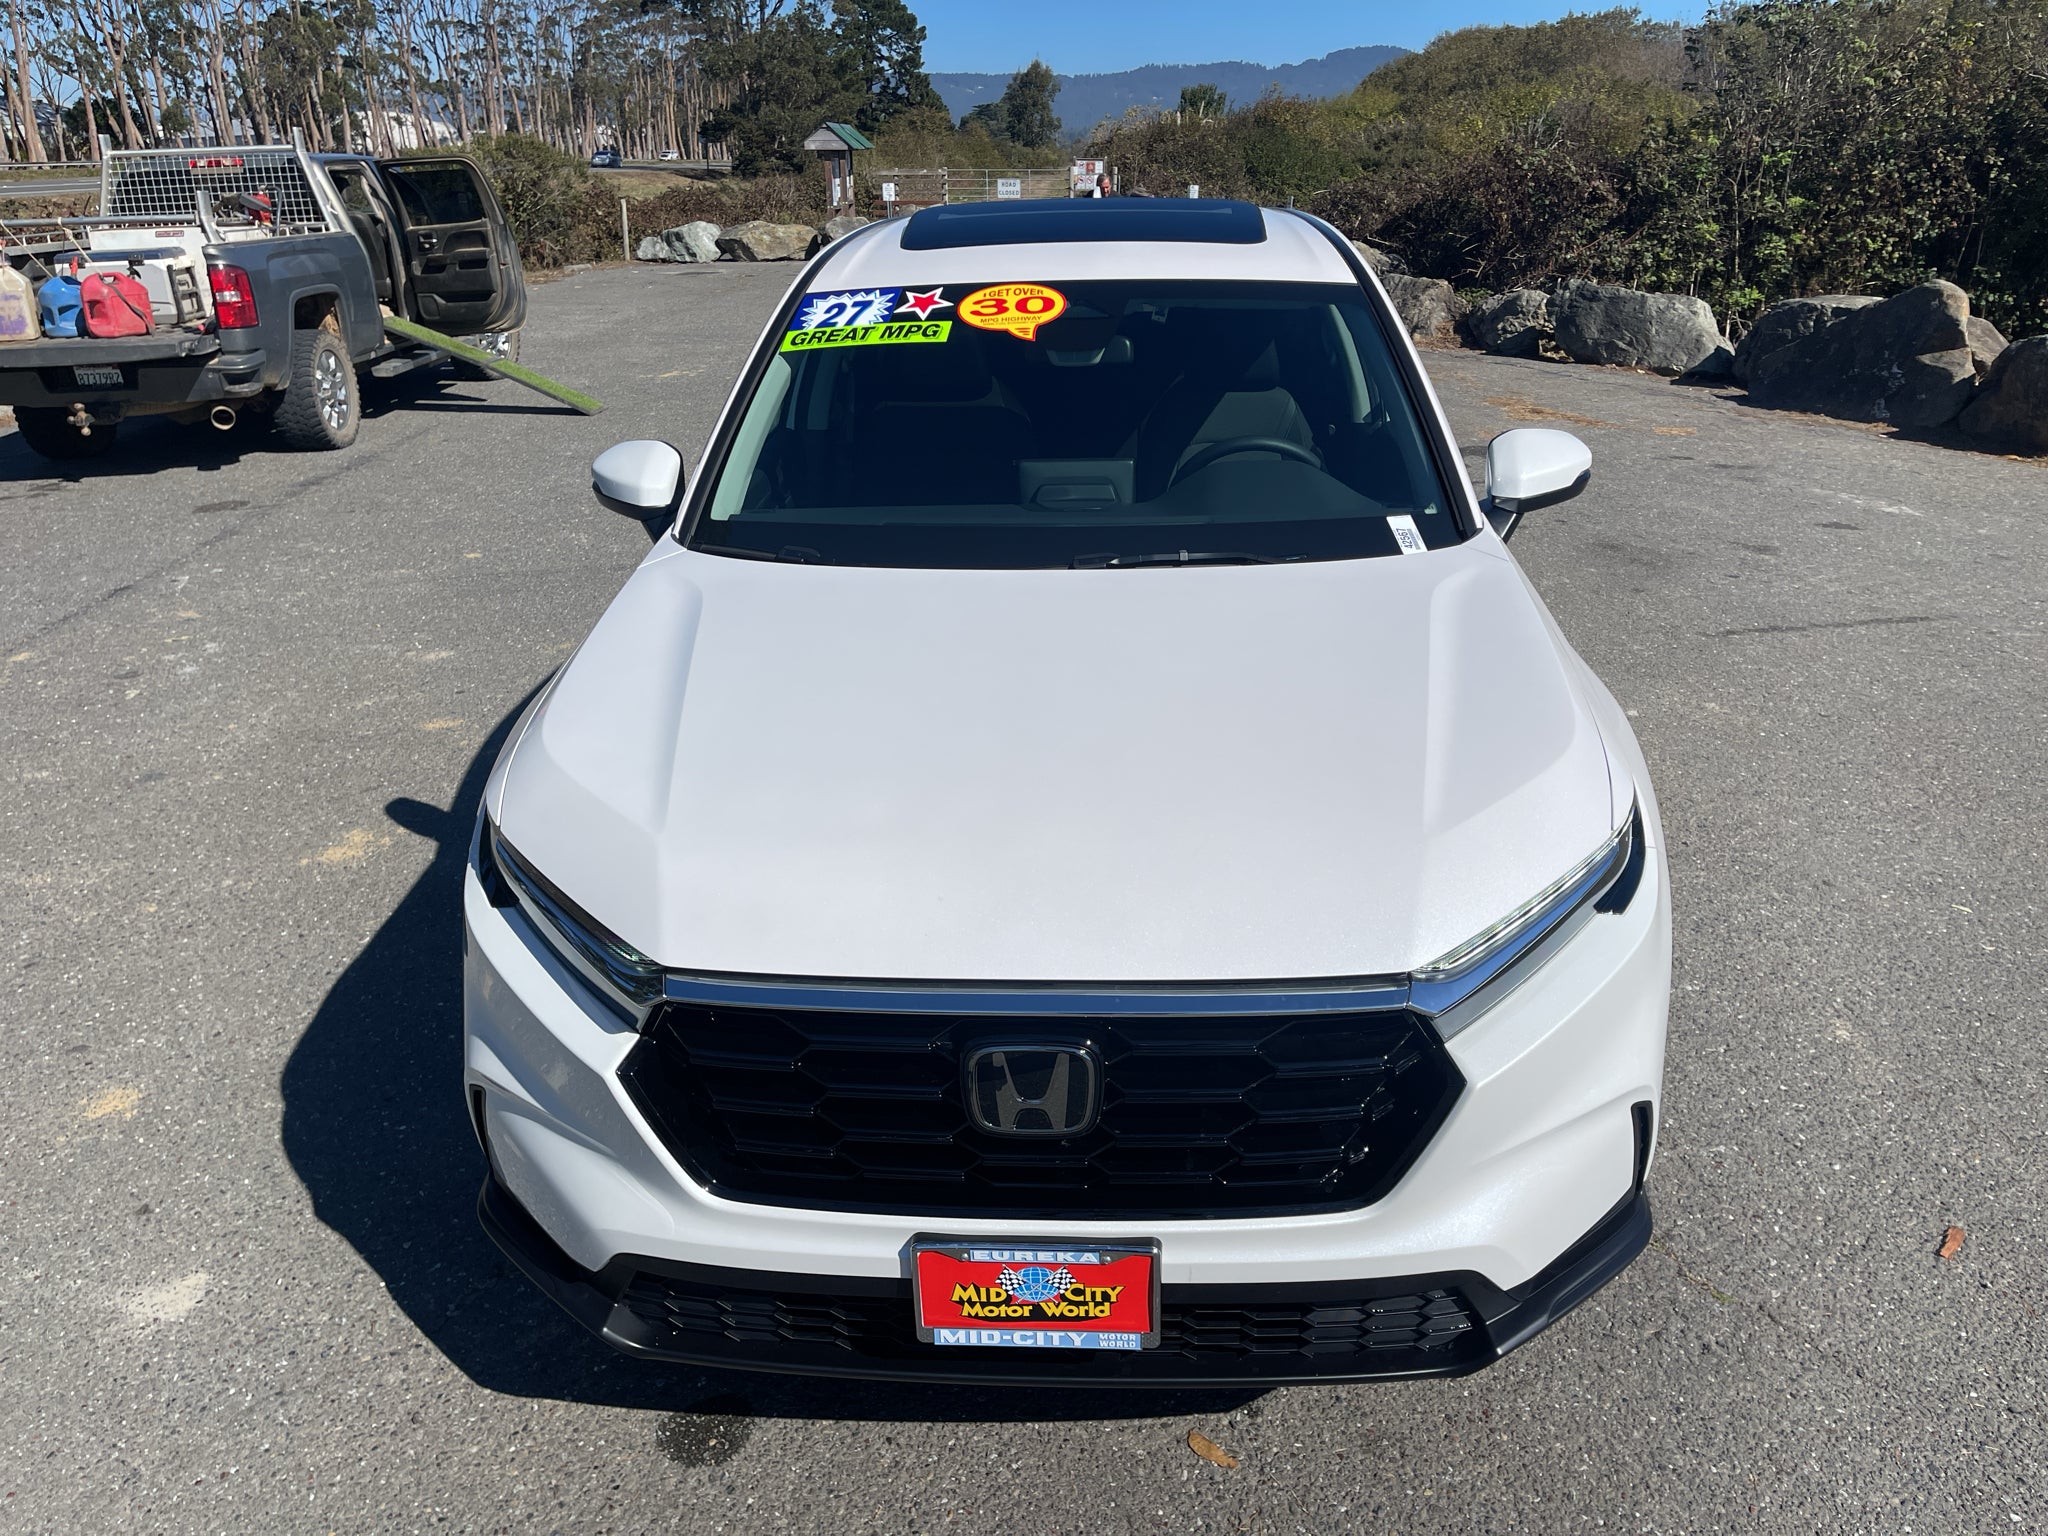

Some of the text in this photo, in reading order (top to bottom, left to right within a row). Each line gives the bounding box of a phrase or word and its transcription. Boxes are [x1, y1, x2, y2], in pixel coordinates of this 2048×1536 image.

[988, 288, 1011, 297] GET
[1013, 287, 1044, 296] OVER
[814, 300, 875, 328] 27
[970, 296, 1055, 316] 30
[790, 323, 942, 346] GREAT MPG
[1395, 528, 1414, 549] 42567
[973, 1250, 1099, 1263] EUREKA
[951, 1283, 1125, 1302] MID CITY
[961, 1302, 1111, 1317] Motor World
[938, 1329, 1088, 1346] MID-CITY
[1099, 1333, 1136, 1341] MOTOR
[1099, 1340, 1136, 1348] WORLD
